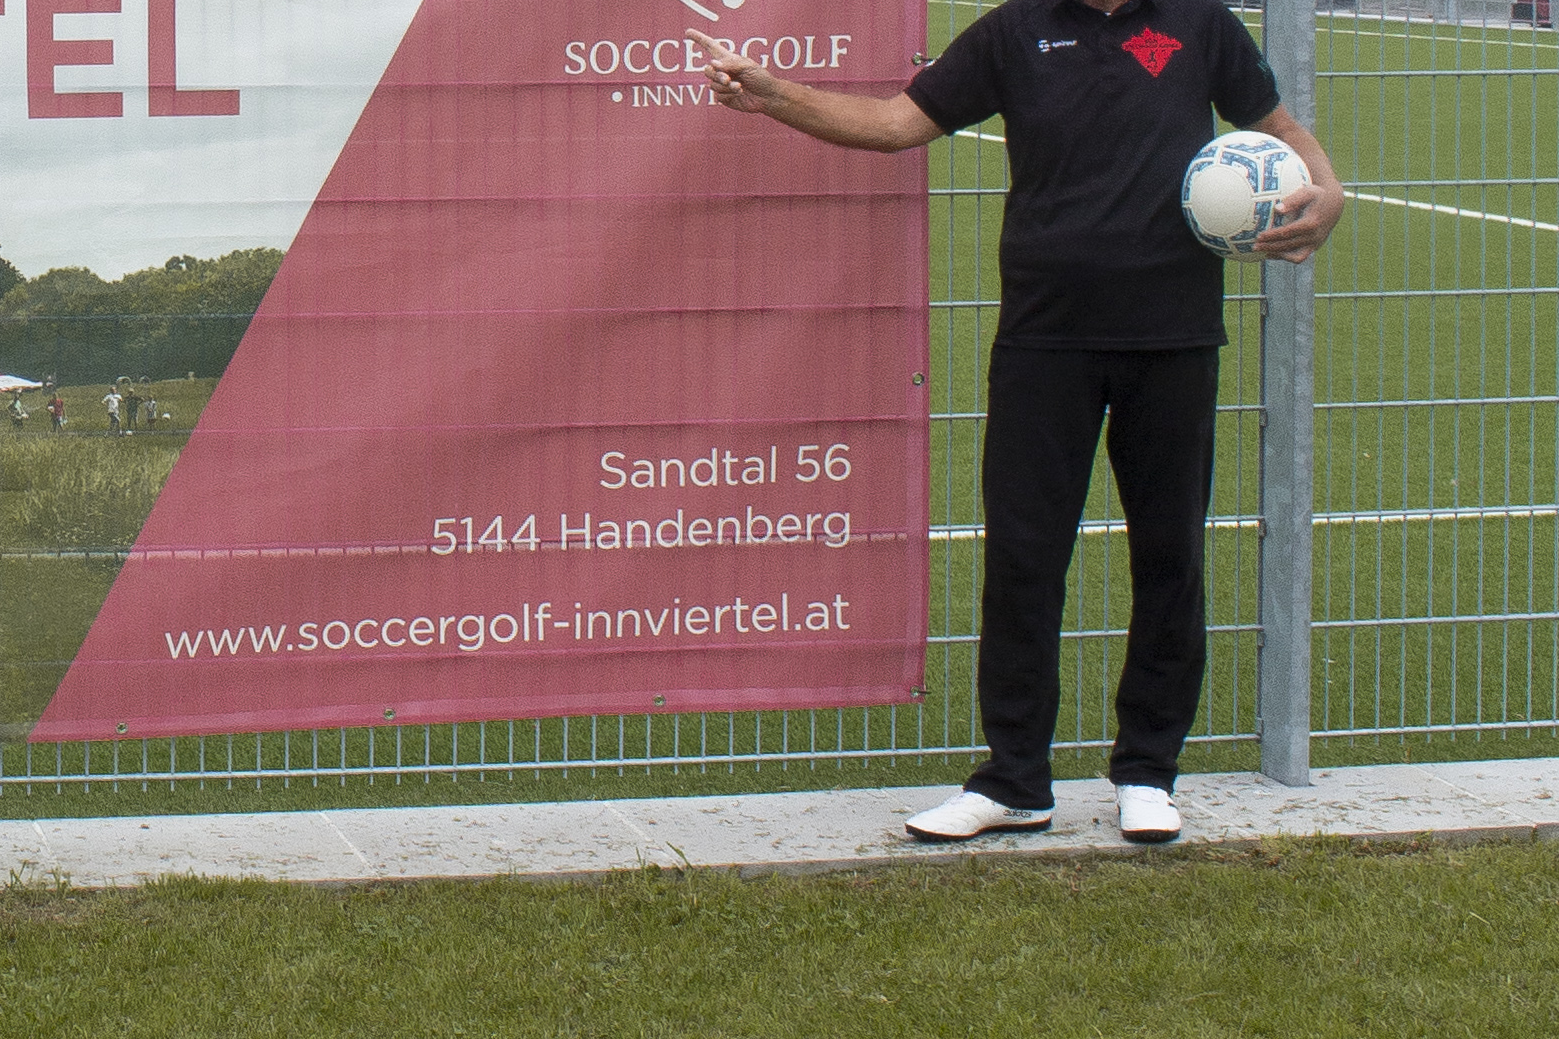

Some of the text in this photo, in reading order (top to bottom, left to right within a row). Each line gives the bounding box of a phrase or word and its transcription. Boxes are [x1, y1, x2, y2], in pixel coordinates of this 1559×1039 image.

[600, 443, 852, 489] Sandtal 56
[430, 507, 852, 555] 5144 Handenberg
[165, 592, 851, 659] www.soccergolf-innviertel.at
